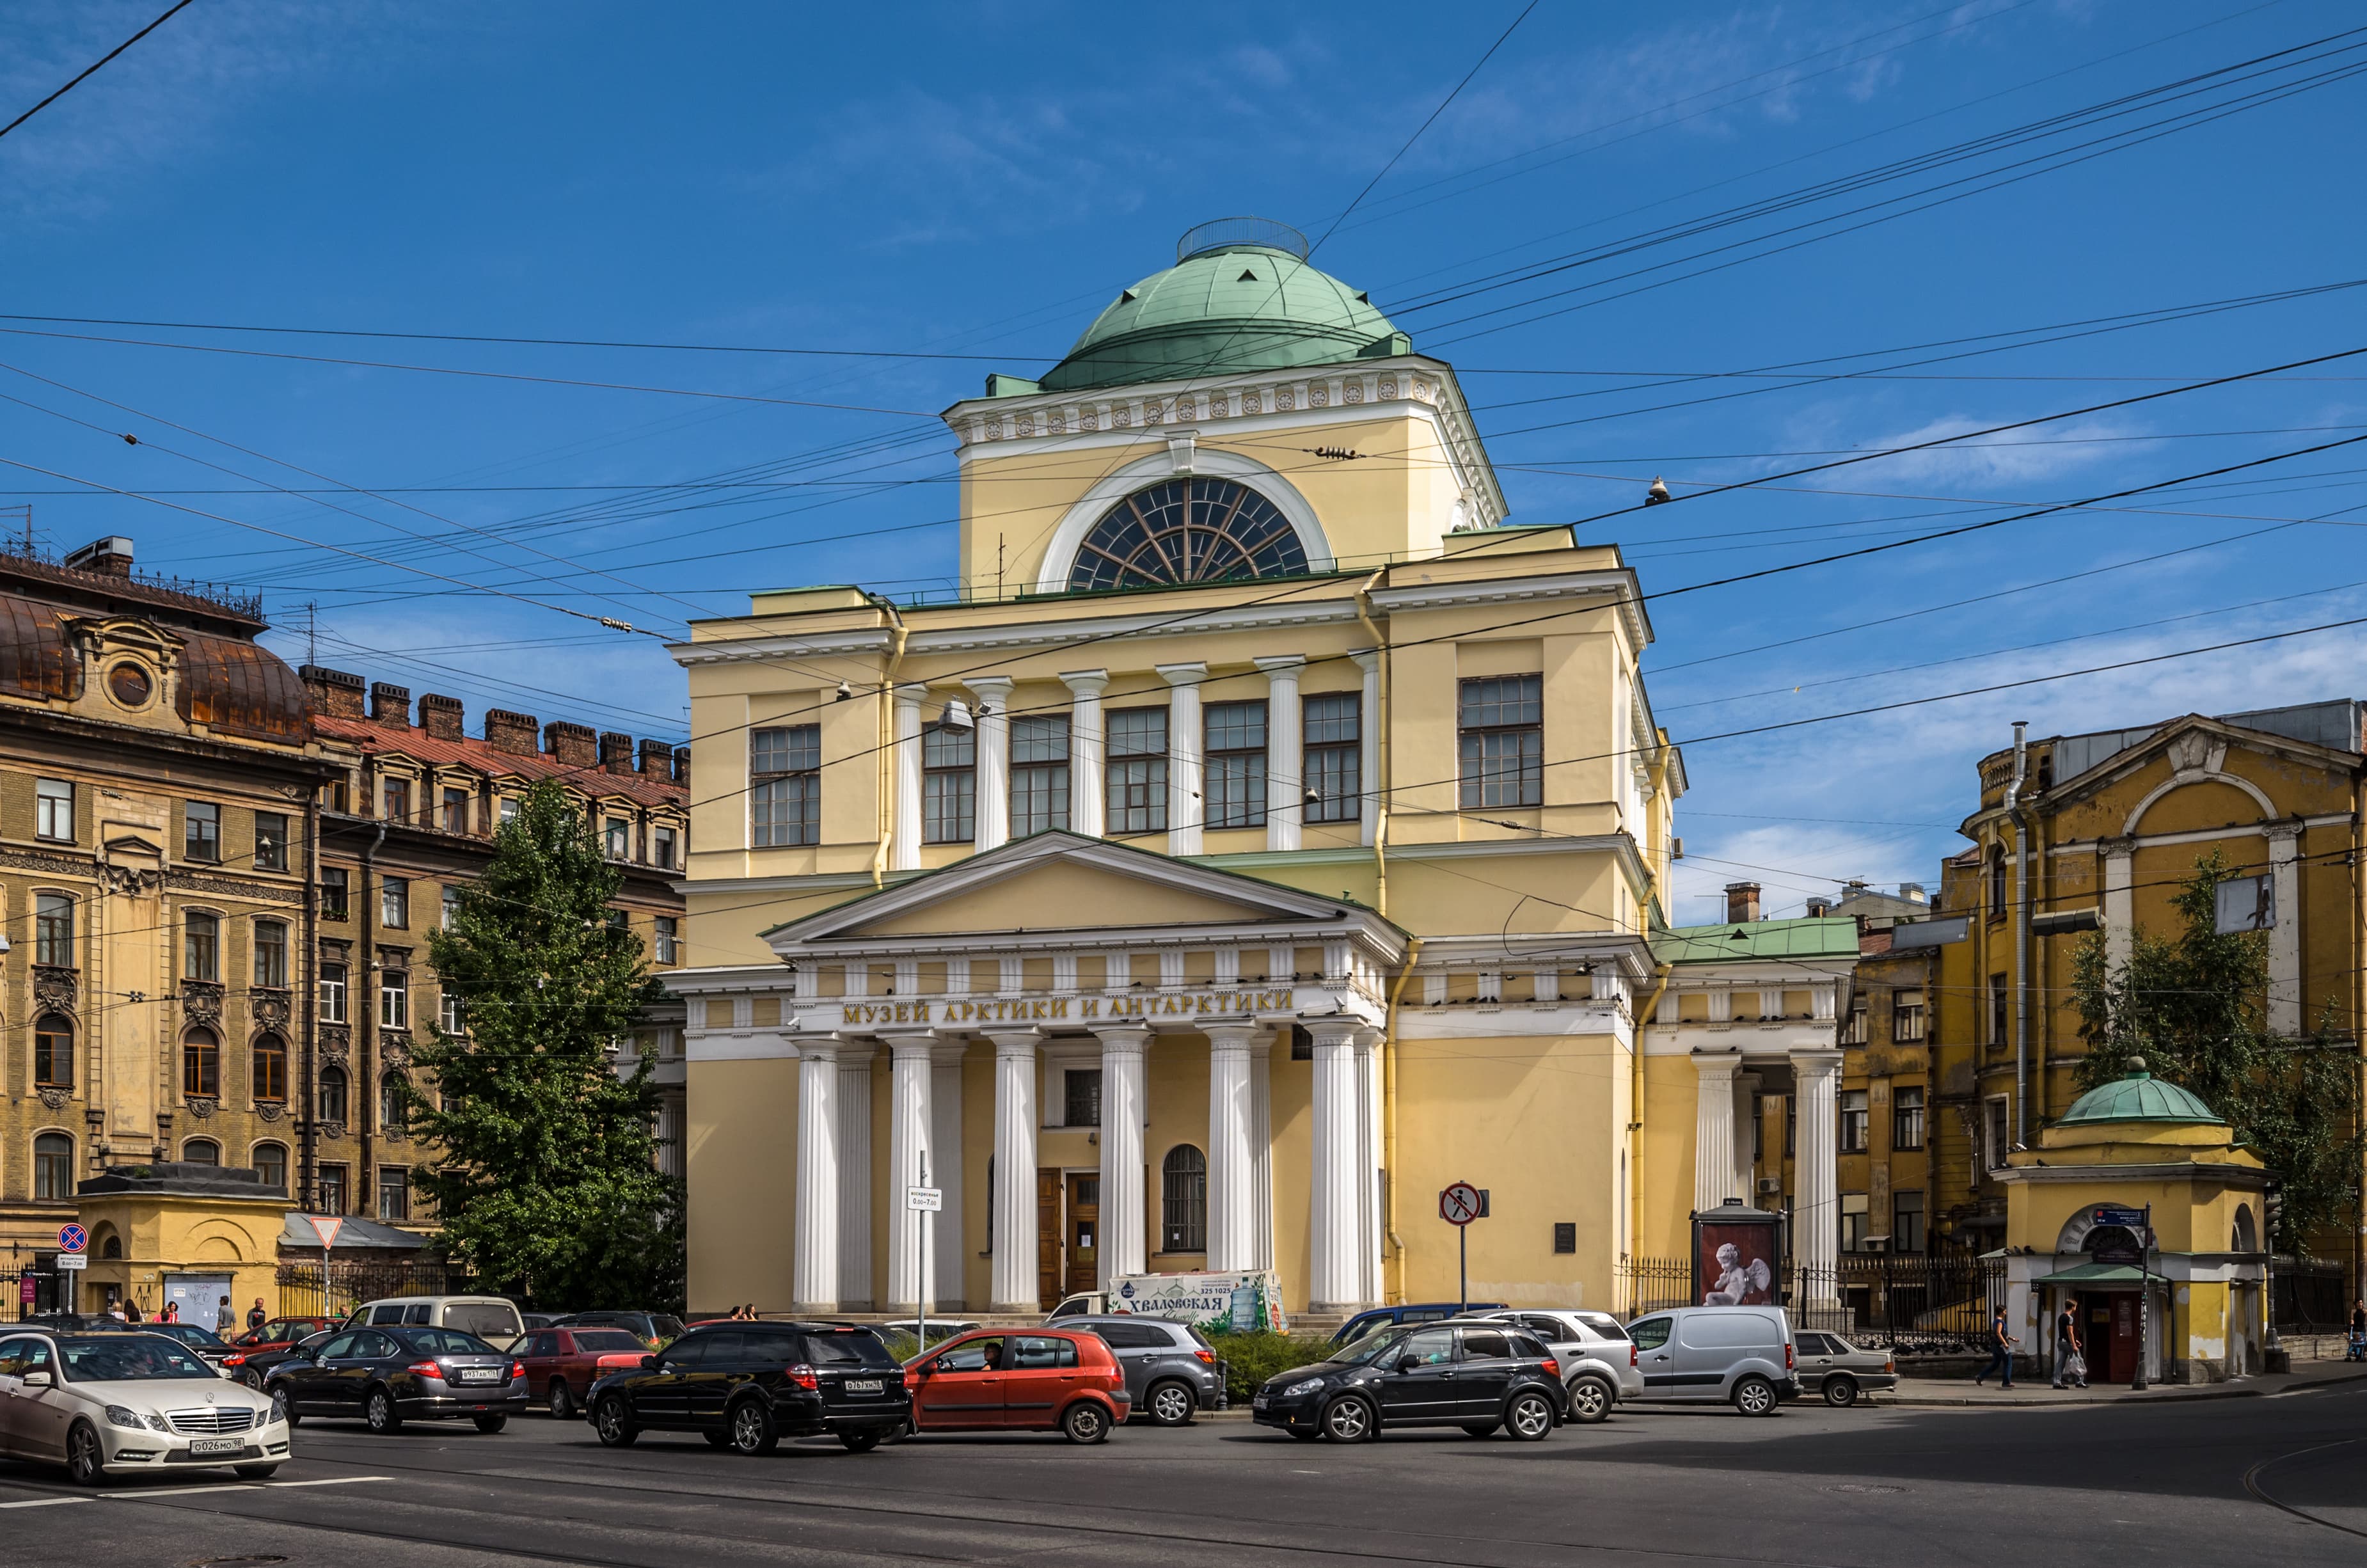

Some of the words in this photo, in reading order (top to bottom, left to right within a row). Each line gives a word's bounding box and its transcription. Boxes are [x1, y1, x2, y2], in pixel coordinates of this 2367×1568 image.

[843, 999, 930, 1024] МУЗЕЙ
[944, 999, 1069, 1022] АРКТИКИ
[1081, 999, 1099, 1017] И
[1109, 991, 1294, 1015] АНТАРКТИКИ
[1129, 1297, 1223, 1313] ХВАЛОВСКАЯ
